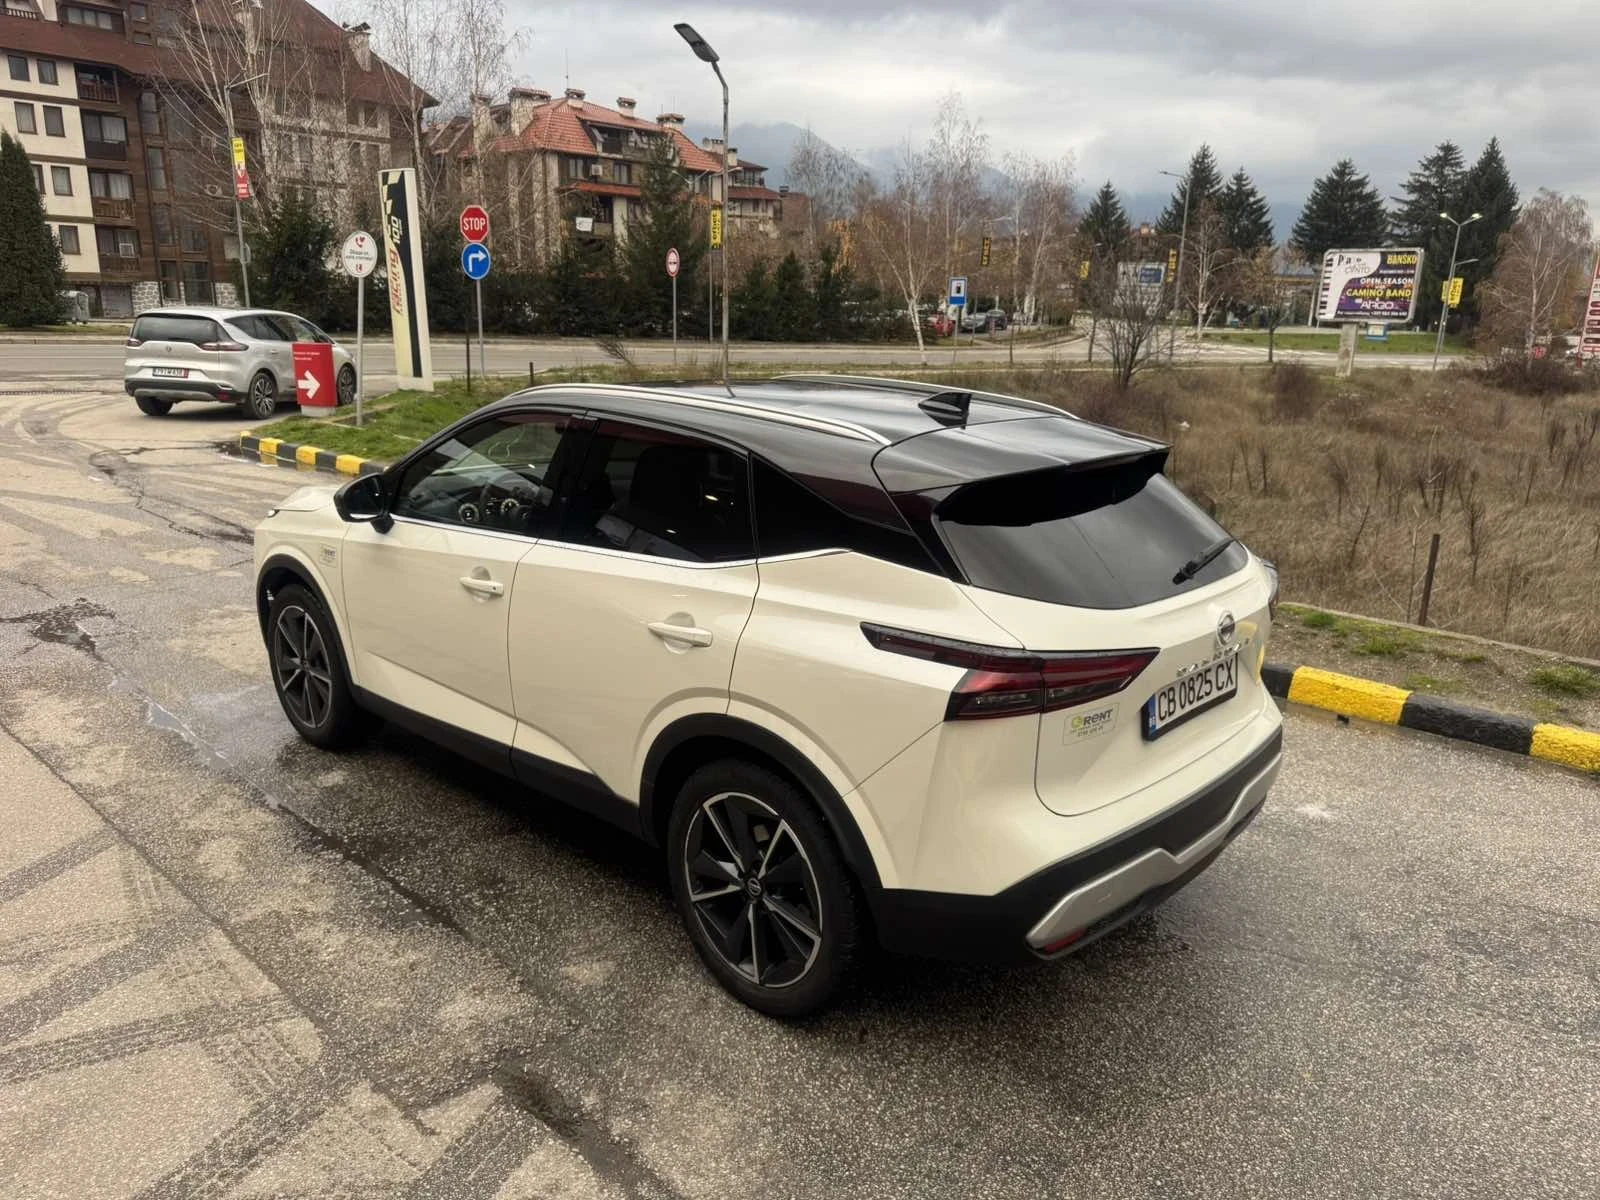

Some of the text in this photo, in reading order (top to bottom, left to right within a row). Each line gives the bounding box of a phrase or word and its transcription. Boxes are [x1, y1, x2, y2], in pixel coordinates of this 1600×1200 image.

[391, 215, 401, 244] 100
[463, 217, 486, 231] STOP
[1386, 254, 1418, 265] BANSKO
[1360, 277, 1414, 285] OPEN SEASON
[1346, 288, 1412, 297] CAMINO BAND
[1158, 658, 1234, 721] CB 0825 CX
